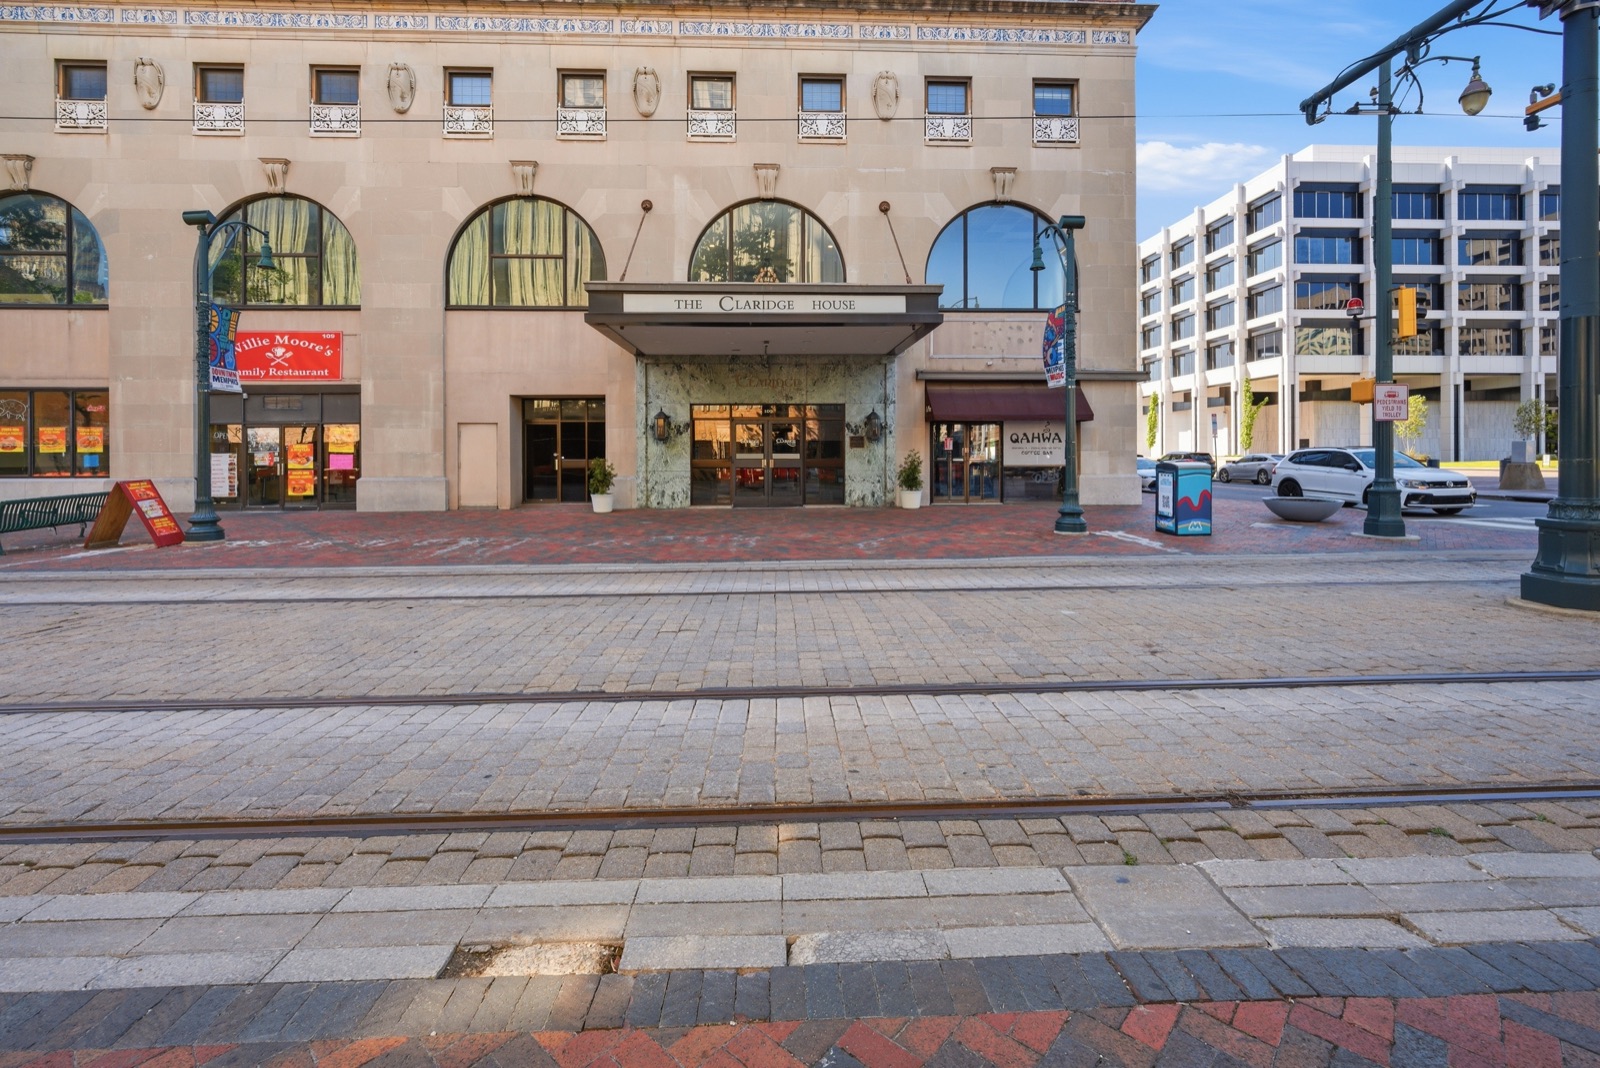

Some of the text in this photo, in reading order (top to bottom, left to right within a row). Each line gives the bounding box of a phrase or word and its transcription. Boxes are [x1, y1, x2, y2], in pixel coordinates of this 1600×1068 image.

[674, 296, 856, 311] THE CLARIDGE HOUSE
[274, 334, 334, 357] Moore's
[237, 367, 329, 378] amily Restaurant
[212, 375, 239, 386] MEMPHIS
[1010, 432, 1063, 444] QAHWA
